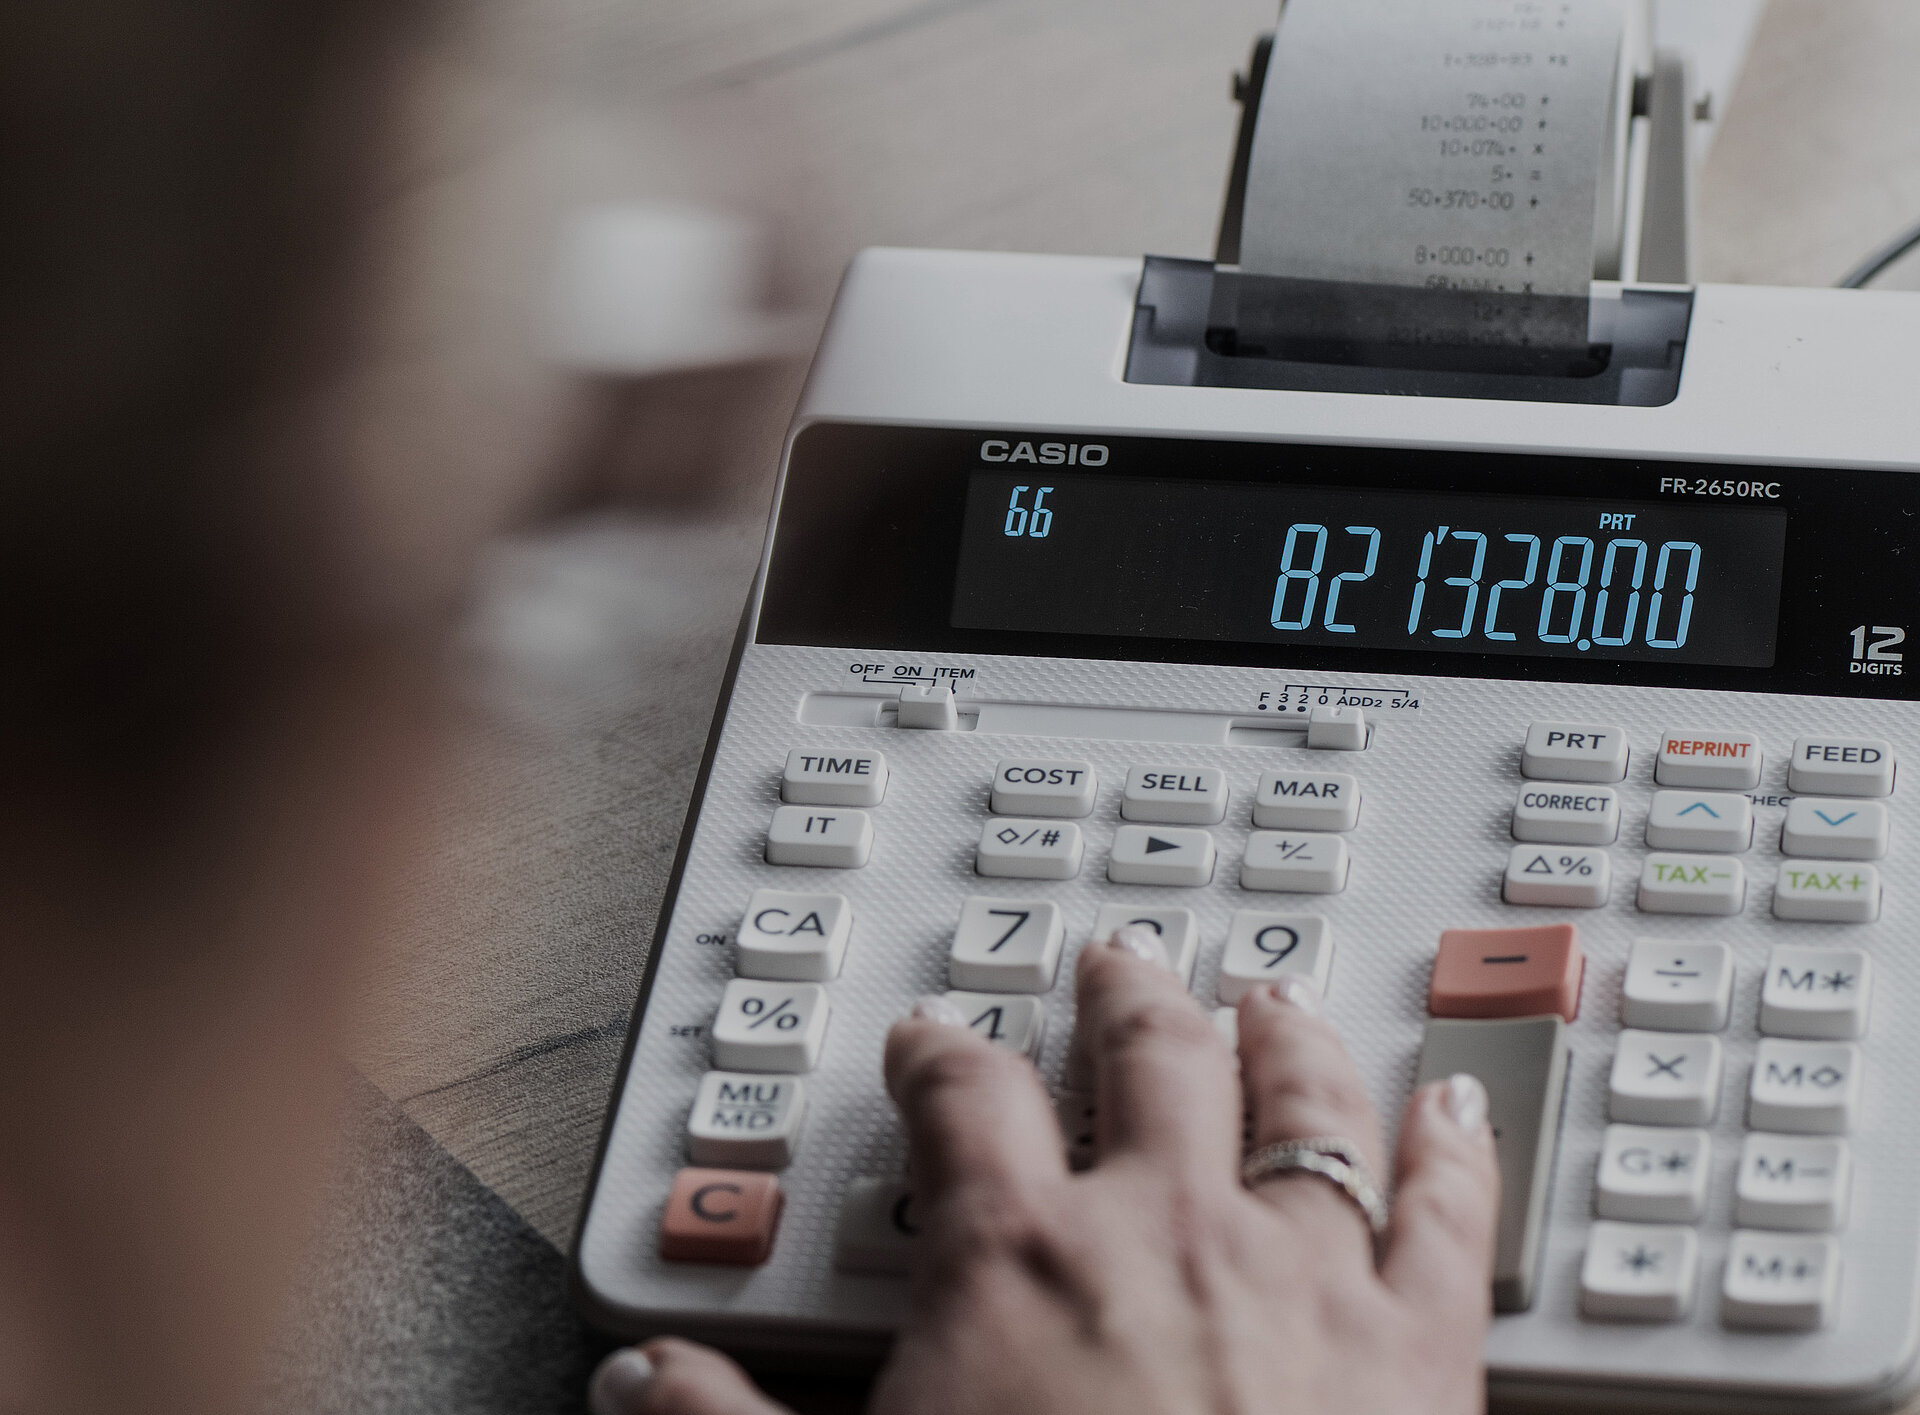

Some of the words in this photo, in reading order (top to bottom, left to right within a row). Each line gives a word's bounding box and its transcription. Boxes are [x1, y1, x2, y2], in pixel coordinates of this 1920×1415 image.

[980, 439, 1109, 467] CASIO
[1659, 477, 1781, 499] FR-2650RC
[1004, 485, 1055, 538] 66
[1599, 512, 1636, 531] PRT
[1850, 624, 1906, 662] 12
[850, 663, 885, 675] OFF
[894, 665, 922, 677] ON
[933, 666, 976, 679] ITEM
[1849, 661, 1903, 676] DIGITS
[1259, 692, 1271, 702] F
[1278, 692, 1290, 704] 3
[1298, 693, 1310, 704] 2
[1336, 695, 1383, 708] ADD2
[1391, 698, 1420, 710] 5/4
[1546, 731, 1607, 751] PRT
[1666, 739, 1752, 759] REPRINT
[1805, 745, 1882, 764] FEED
[800, 756, 872, 775] TIME
[1004, 766, 1084, 787] COST
[1141, 773, 1209, 793] SELL
[1273, 780, 1340, 799] MAR
[1523, 792, 1610, 813] CORRECT
[805, 816, 836, 835] IT
[1786, 871, 1867, 893] TAX+
[754, 908, 825, 937] CA
[987, 909, 1030, 952] 7
[695, 933, 726, 947] ON
[1254, 925, 1299, 969] 9
[741, 998, 799, 1030] %
[670, 1023, 705, 1039] SET
[718, 1081, 781, 1103] MU
[711, 1109, 774, 1130] MD
[690, 1182, 743, 1223] C
